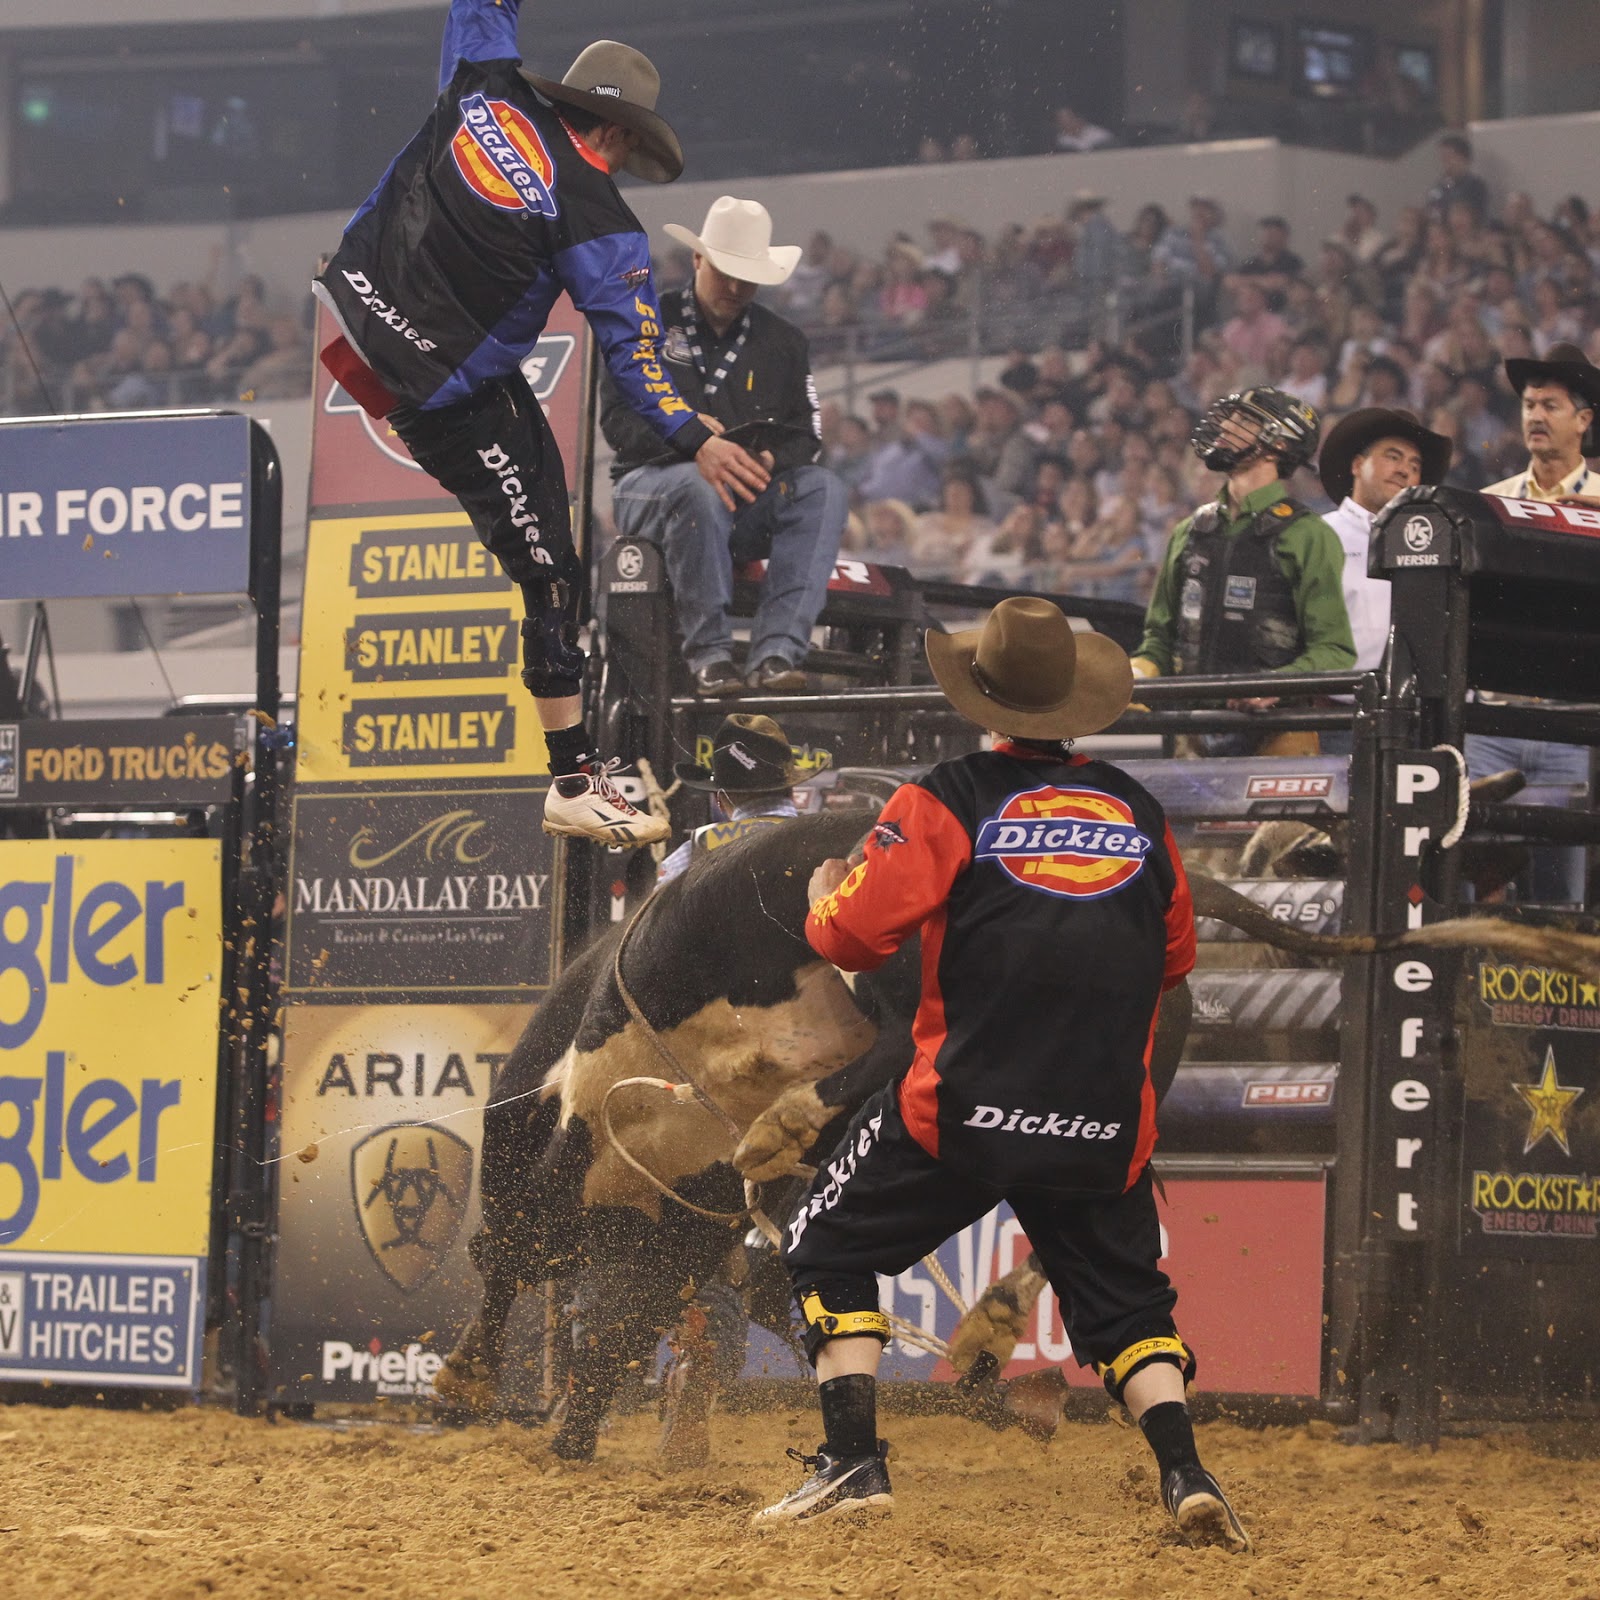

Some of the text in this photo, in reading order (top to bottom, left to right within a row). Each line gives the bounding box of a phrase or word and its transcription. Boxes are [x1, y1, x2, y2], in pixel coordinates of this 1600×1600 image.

[466, 105, 543, 203] Dickies
[341, 269, 438, 353] Dickies
[57, 482, 244, 536] FORCE
[477, 443, 554, 566] Dickies
[1396, 554, 1440, 566] VERSUS
[358, 625, 506, 668] STANLEY
[355, 711, 503, 752] STANLEY
[25, 742, 230, 782] FORD TRUCKS
[1251, 778, 1329, 793] PBR
[990, 824, 1147, 854] Dickies
[294, 874, 549, 914] MANDALAY BAY
[1492, 1003, 1555, 1024] ENERGY
[315, 1053, 513, 1097] ARIAT
[1249, 1083, 1327, 1101] PBR
[963, 1104, 1122, 1141] Dickies
[787, 1108, 883, 1254] Dickies
[1483, 1211, 1597, 1234] ENERGY DRINK
[30, 1273, 176, 1316] TRAILER
[29, 1320, 175, 1364] HITCHES
[322, 1341, 448, 1383] Priefe
